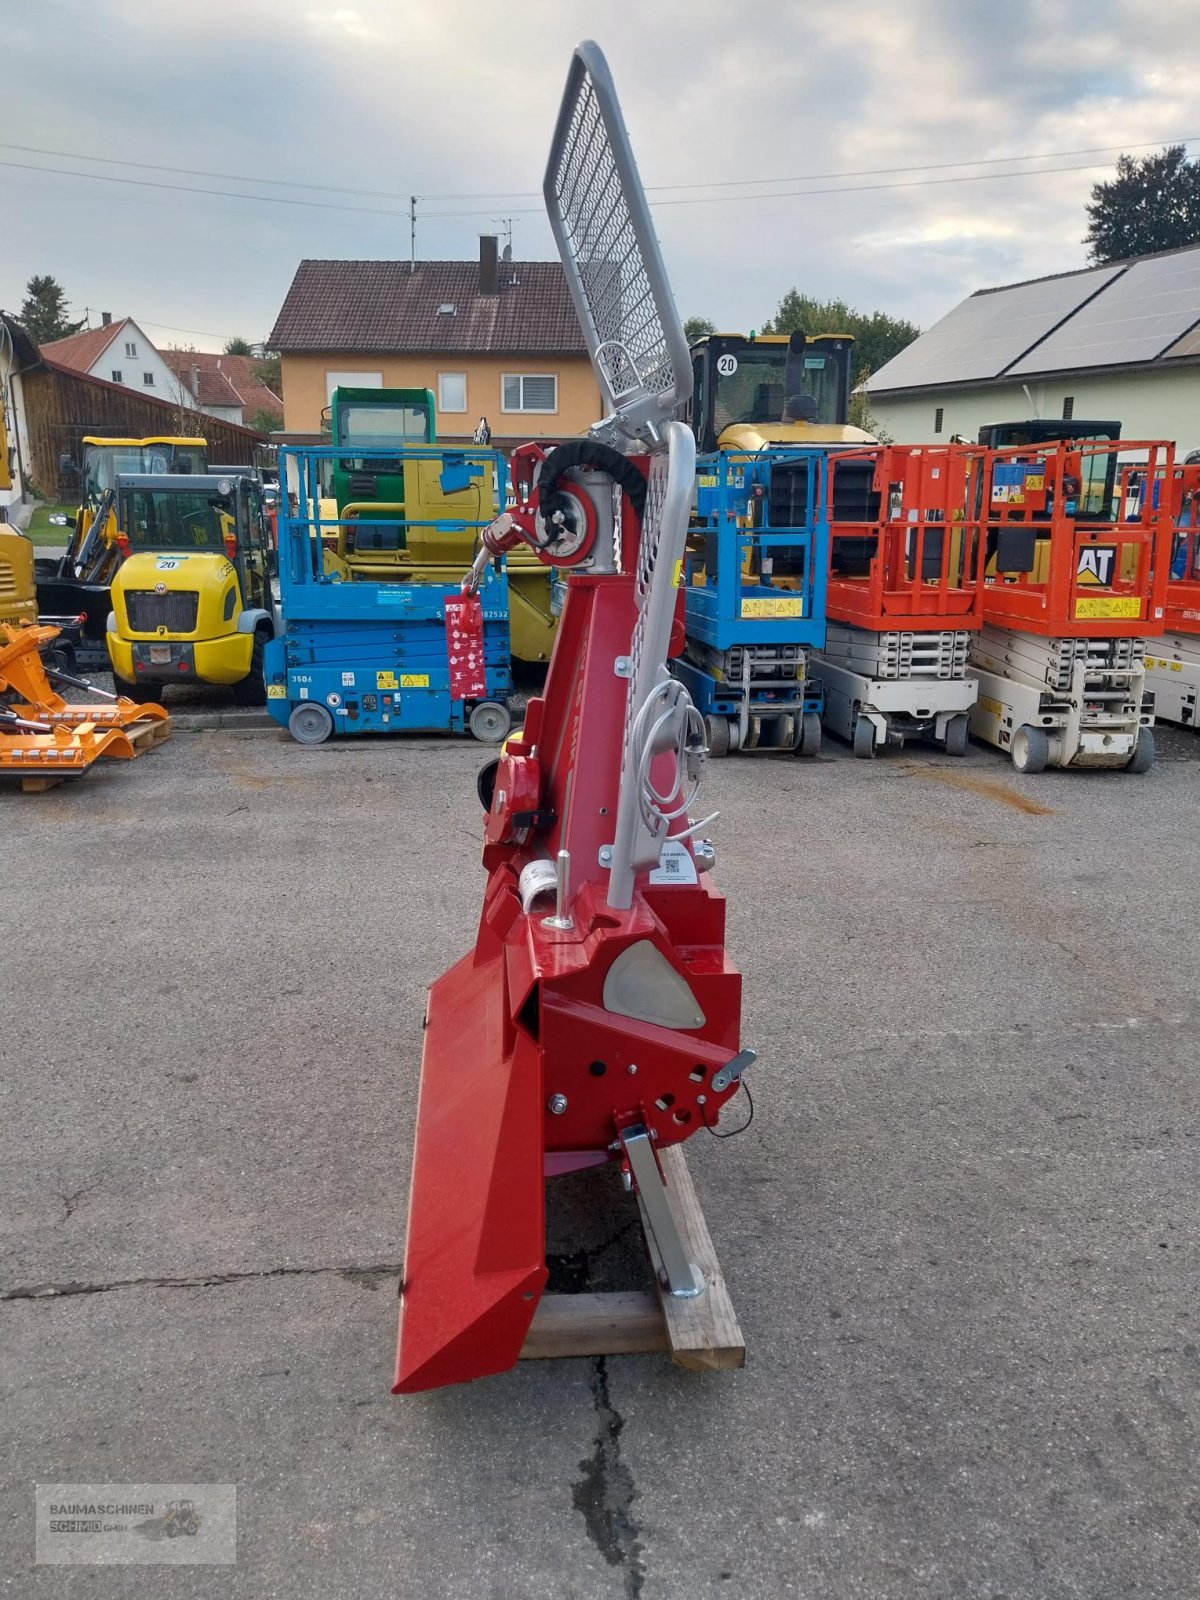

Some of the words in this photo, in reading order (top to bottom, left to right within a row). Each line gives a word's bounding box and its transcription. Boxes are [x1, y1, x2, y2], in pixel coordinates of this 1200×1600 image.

[721, 359, 734, 371] 20
[160, 561, 176, 569] 20
[1077, 549, 1113, 584] AT
[291, 675, 313, 684] 3506
